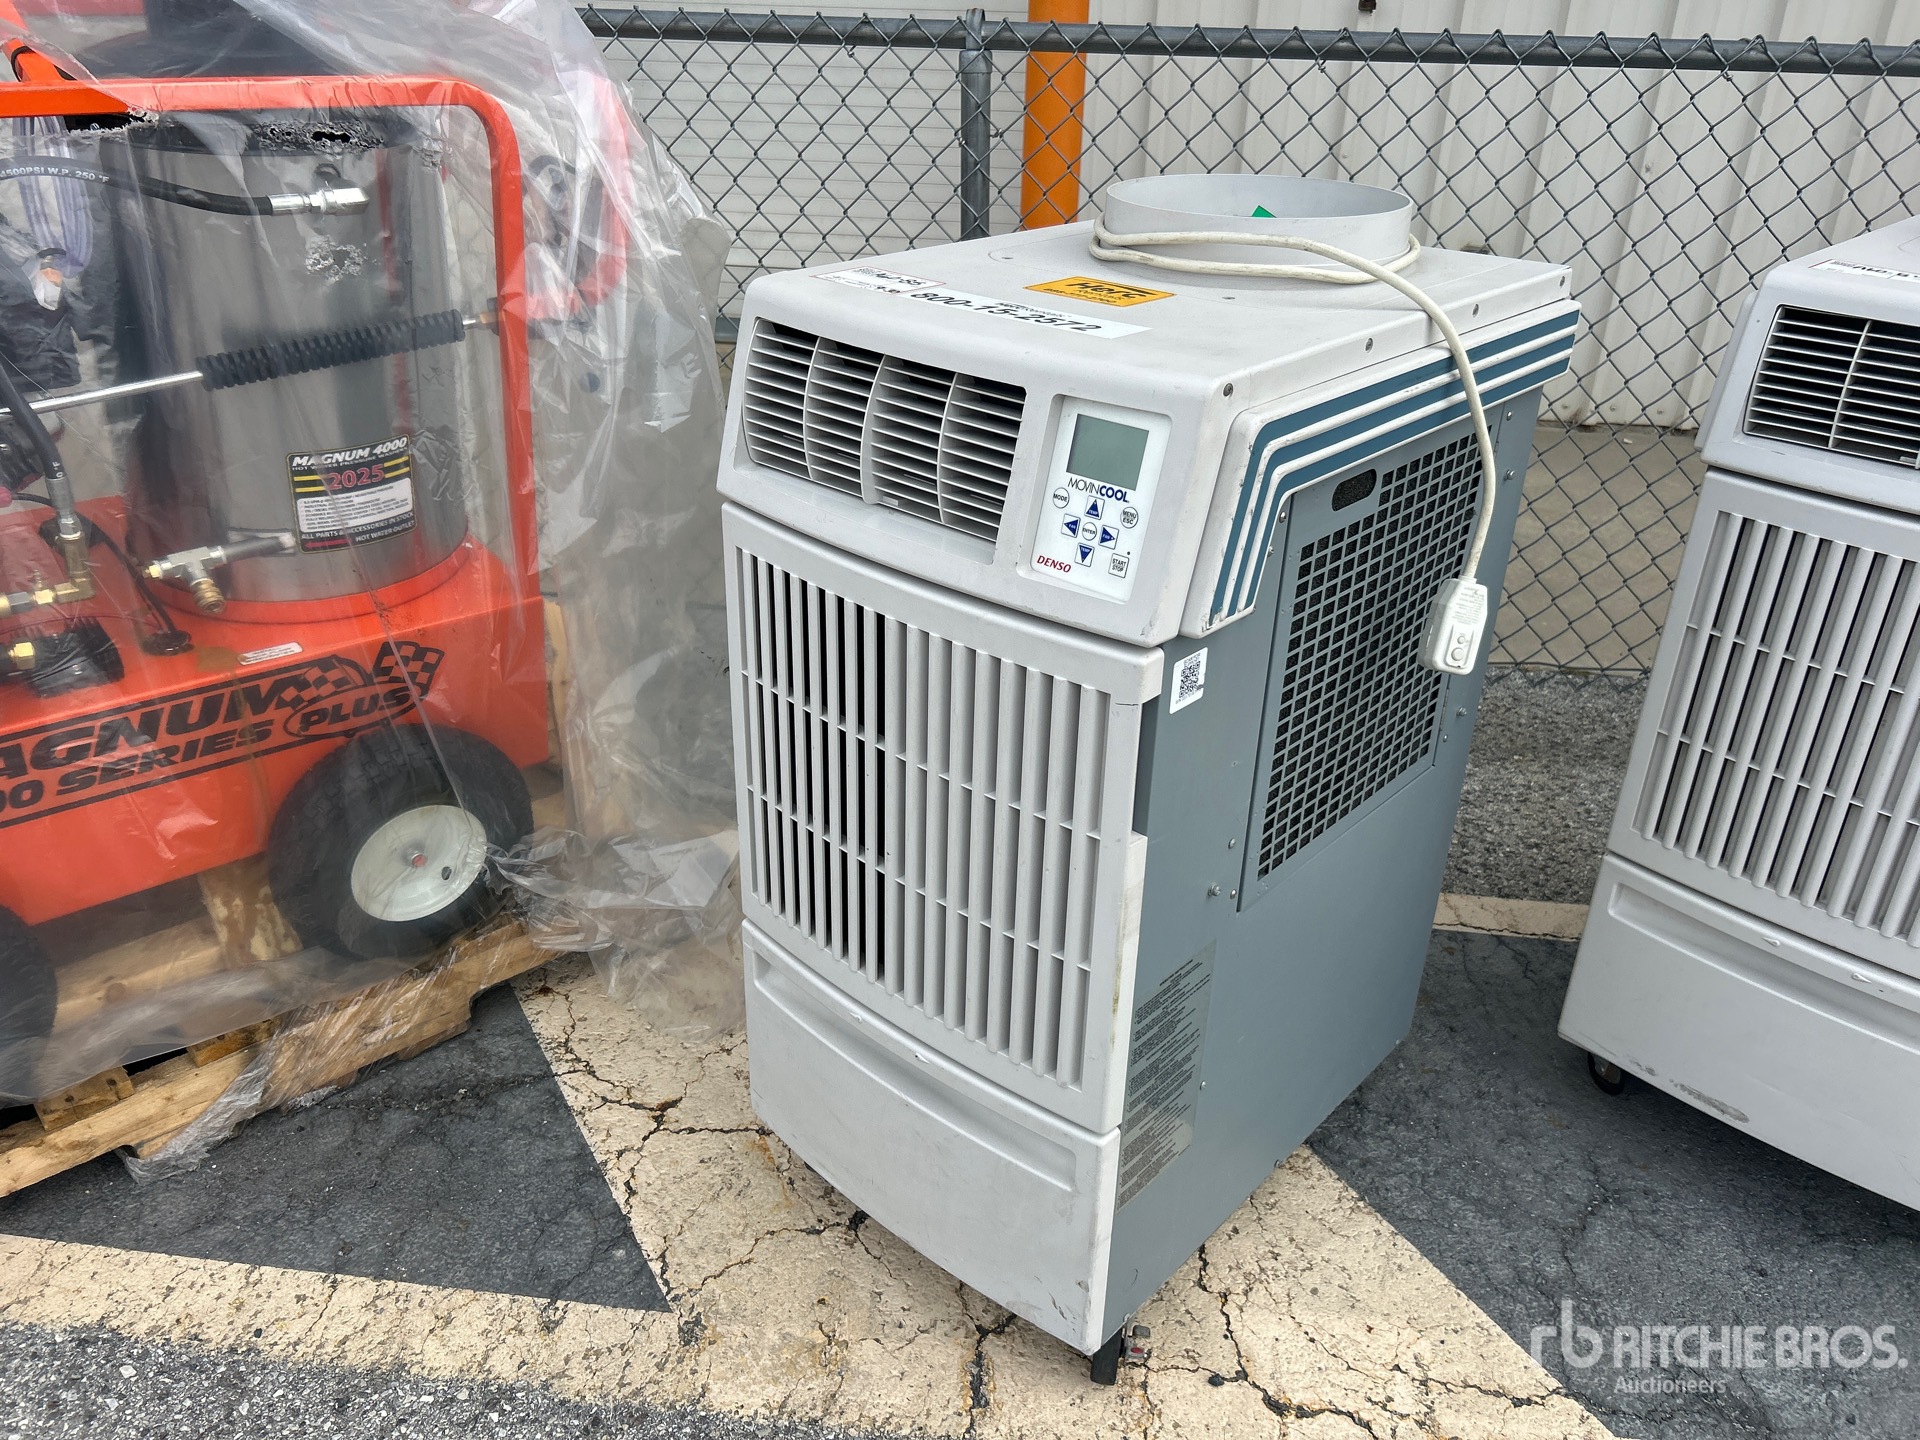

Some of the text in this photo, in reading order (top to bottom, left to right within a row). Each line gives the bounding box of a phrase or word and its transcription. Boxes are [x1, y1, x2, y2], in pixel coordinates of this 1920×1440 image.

[48, 166, 72, 176] W.P.
[75, 170, 96, 180] 250
[910, 292, 1102, 331] 800-15-2572
[292, 437, 407, 466] MAGNUM 4000
[328, 464, 385, 490] 2025
[1053, 493, 1068, 502] MODE
[1122, 510, 1137, 519] MENU
[316, 530, 338, 538] PARTS
[1082, 527, 1096, 535] ENTER
[1036, 555, 1072, 573] DENSO
[1112, 558, 1127, 567] START
[1112, 563, 1124, 572] STOP
[303, 688, 412, 732] PLUS
[56, 719, 277, 797] SERIES
